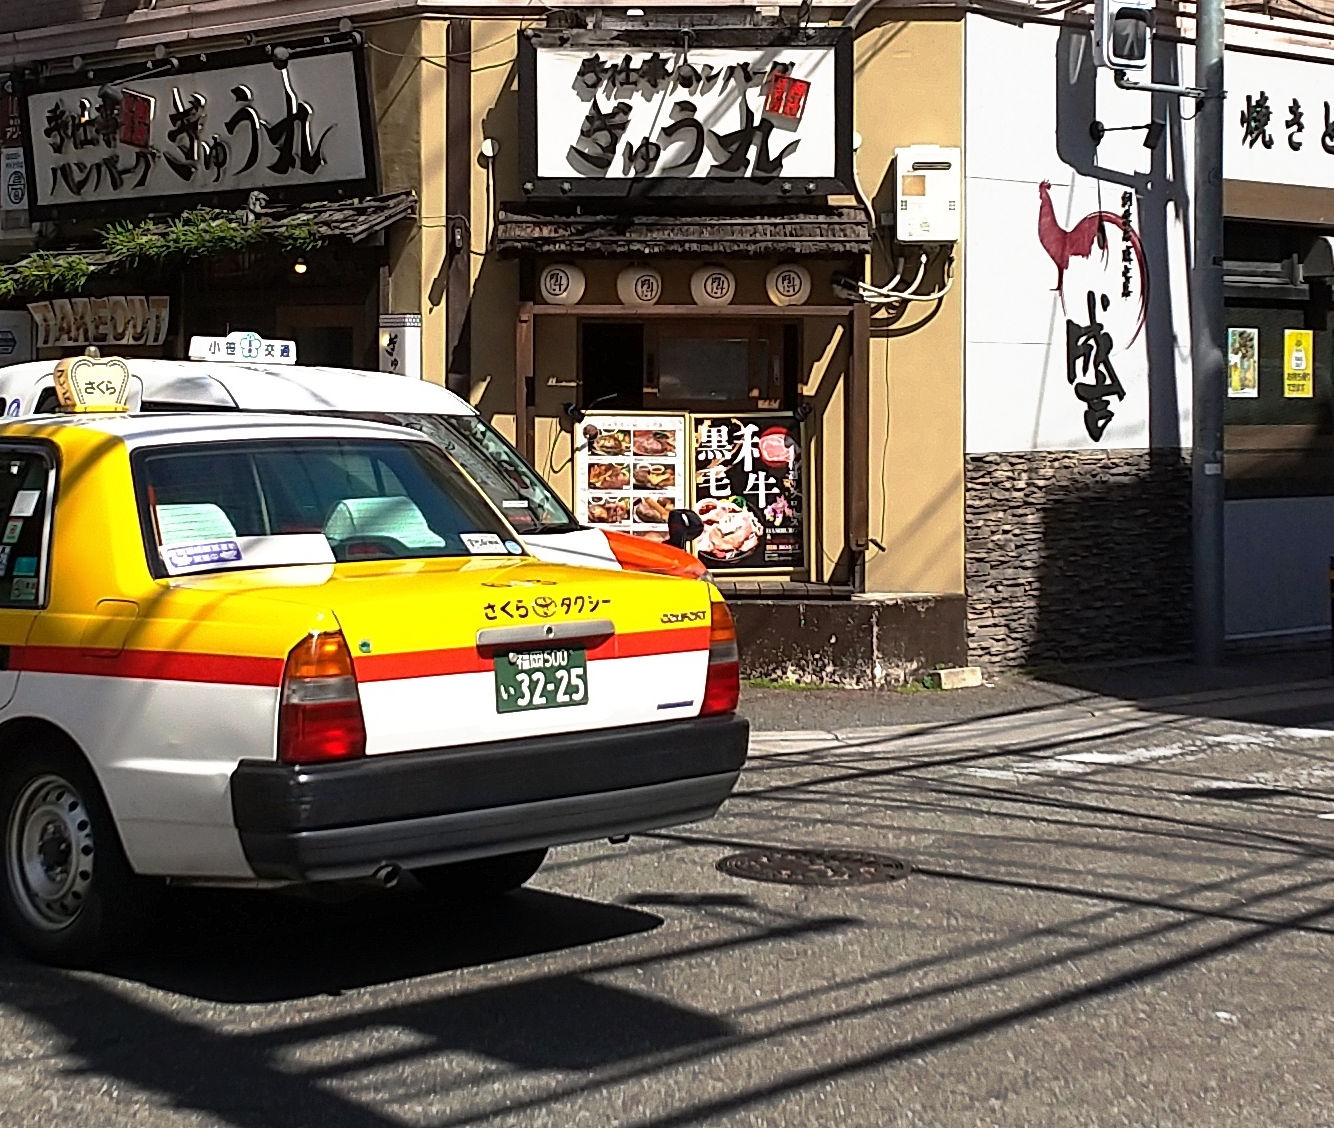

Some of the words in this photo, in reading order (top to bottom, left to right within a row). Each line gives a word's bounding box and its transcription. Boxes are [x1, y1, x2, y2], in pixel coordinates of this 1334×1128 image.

[162, 62, 339, 184] ぎゅう丸
[567, 92, 802, 185] ぎゅう丸
[30, 299, 167, 345] TAKEOUT
[84, 379, 117, 396] さくら
[483, 599, 529, 621] さくら
[560, 595, 611, 615] タクシー
[500, 684, 515, 700] い
[516, 667, 585, 707] 32-25
